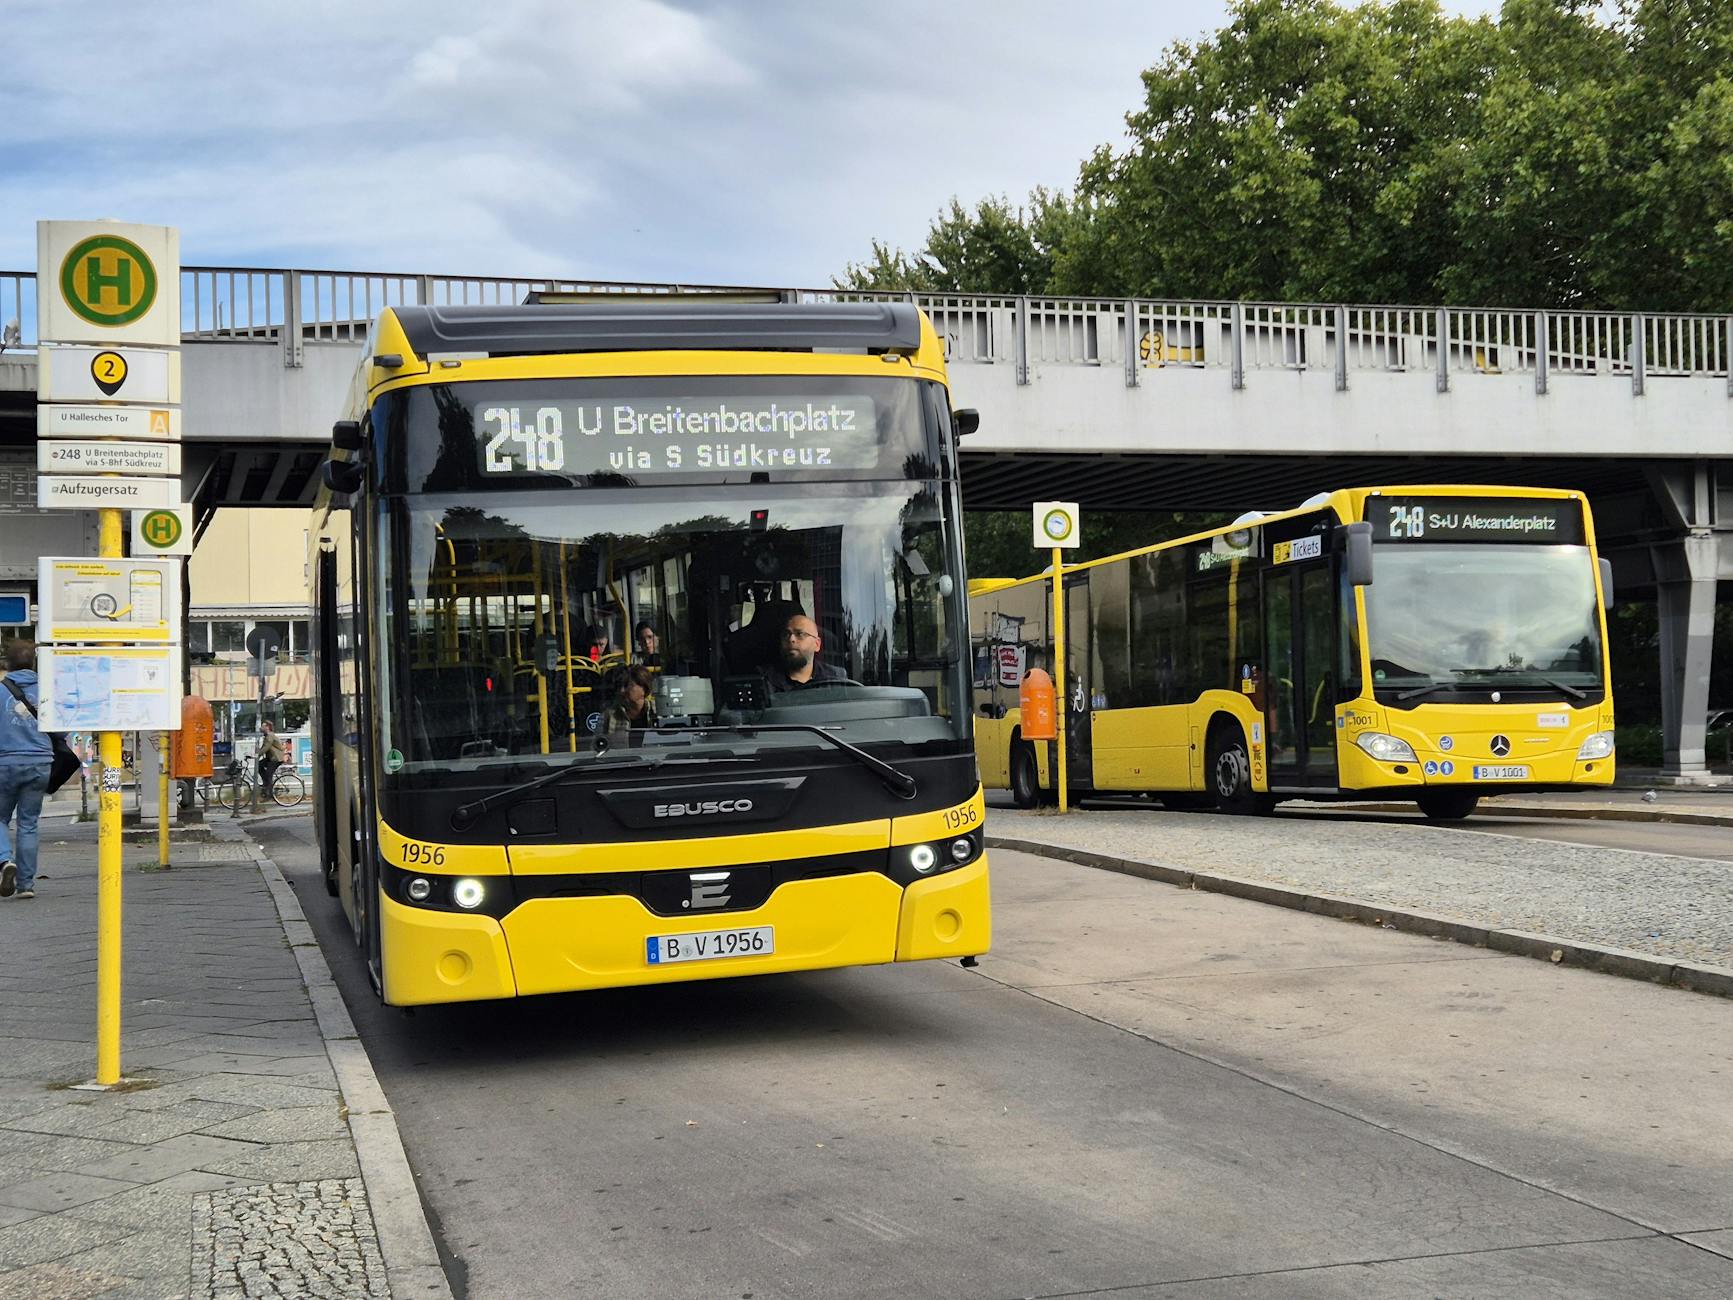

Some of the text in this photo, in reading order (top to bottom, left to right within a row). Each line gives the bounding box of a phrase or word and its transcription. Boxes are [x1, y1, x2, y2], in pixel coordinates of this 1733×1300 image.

[87, 257, 131, 306] H
[104, 360, 115, 377] 2
[61, 413, 129, 422] U Hallesches Tor
[154, 415, 168, 433] A
[578, 404, 856, 439] U Breitenbachplatz
[483, 406, 564, 472] 248
[59, 448, 81, 460] 248
[85, 449, 163, 460] U Breitenbachplatz
[85, 458, 162, 468] via S-Bhf Südkreuz
[609, 444, 832, 470] via S Südkreuz
[59, 483, 138, 498] Aufzugersatz
[152, 518, 171, 539] H
[1389, 506, 1557, 538] 248 S+U Alexanderplatz
[1292, 541, 1319, 558] Tickets
[1352, 716, 1372, 726] 1001
[1481, 767, 1524, 778] B V 1001
[653, 799, 753, 818] EBUSCO
[942, 803, 977, 830] 1956
[400, 842, 446, 866] 1956
[667, 938, 680, 959] B
[695, 936, 707, 956] V
[713, 931, 764, 955] 1956
